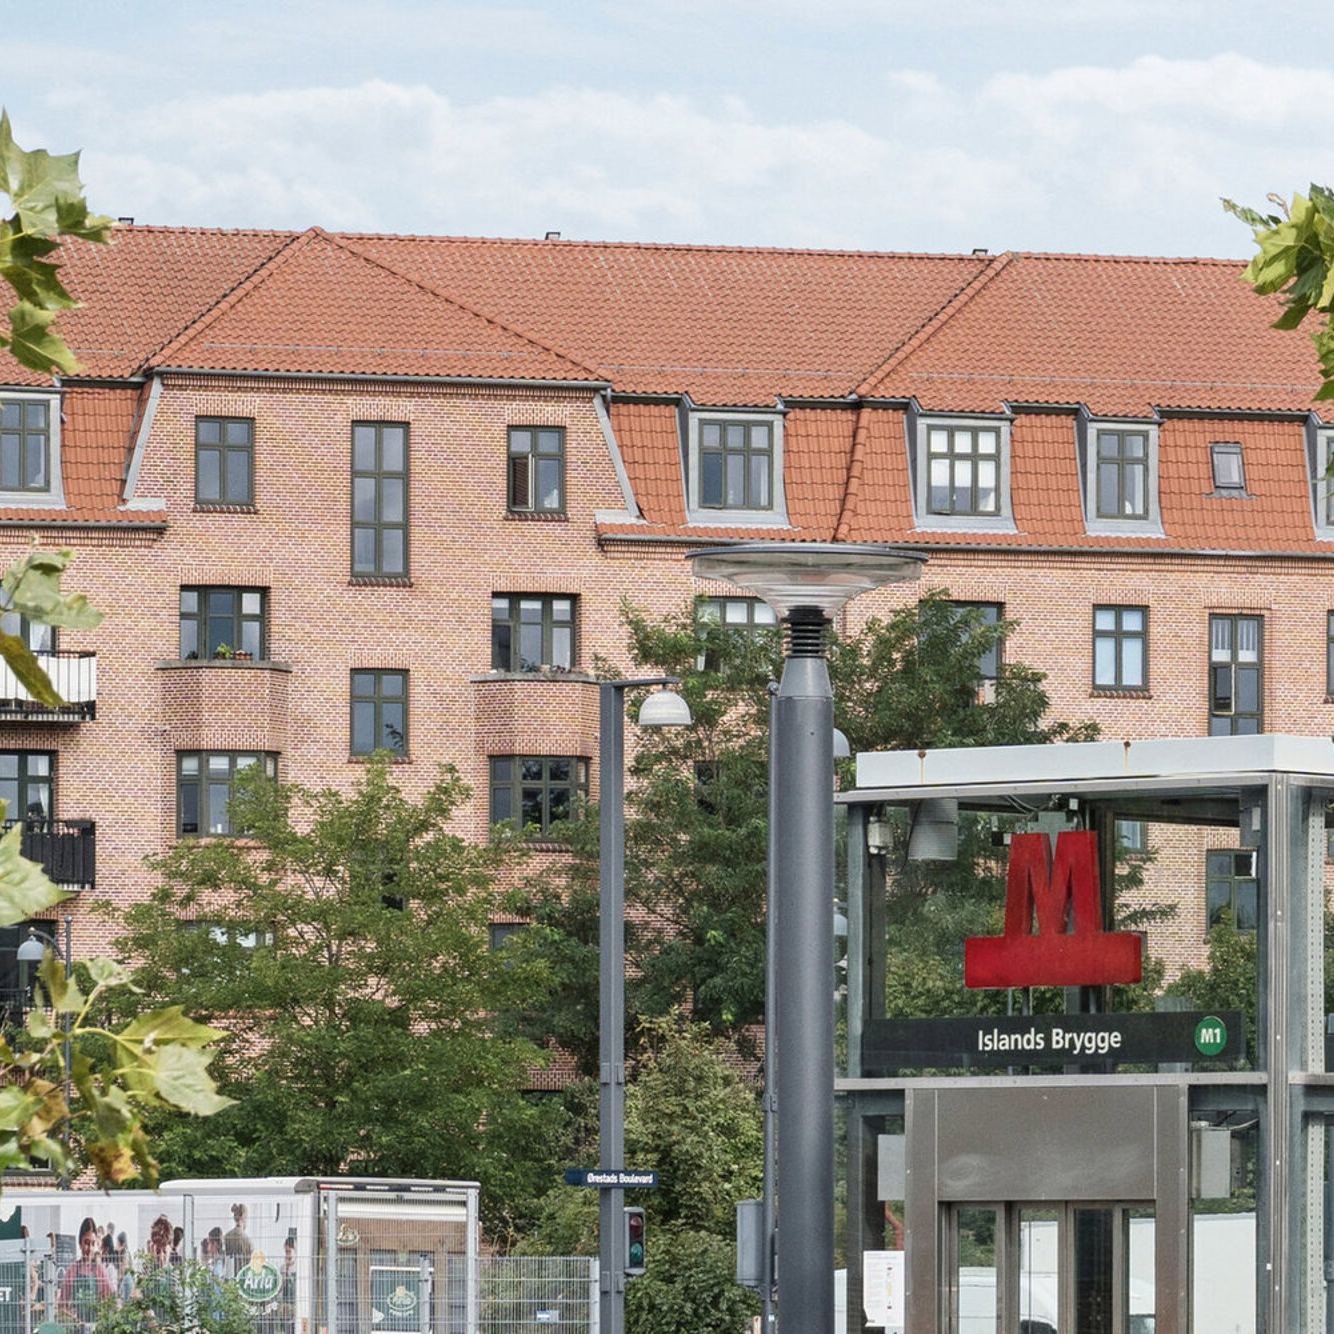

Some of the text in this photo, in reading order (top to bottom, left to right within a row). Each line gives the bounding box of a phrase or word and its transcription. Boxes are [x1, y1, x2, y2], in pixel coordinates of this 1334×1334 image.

[978, 1027, 1122, 1054] Islands Brygge
[1200, 1028, 1221, 1043] M1
[587, 1173, 654, 1184] Ørestads Boulevard
[244, 1269, 273, 1289] Arla
